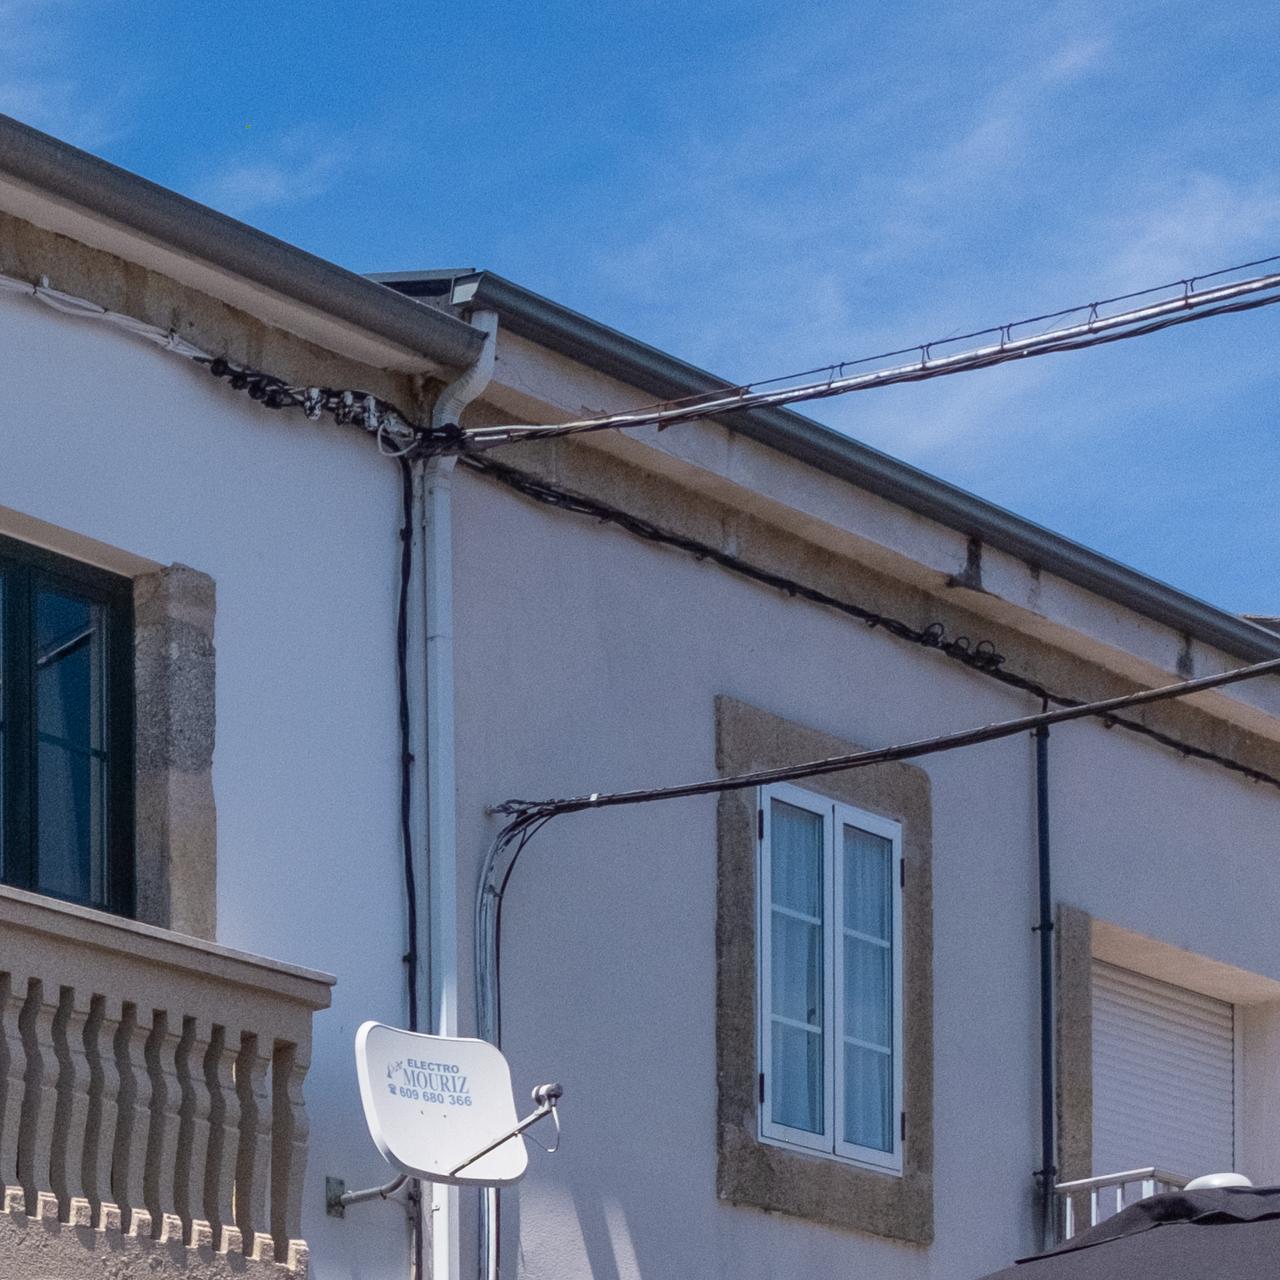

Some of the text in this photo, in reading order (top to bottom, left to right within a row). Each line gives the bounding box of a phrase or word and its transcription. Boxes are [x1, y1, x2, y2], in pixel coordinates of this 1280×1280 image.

[407, 1058, 459, 1074] ELECTRO
[403, 1069, 469, 1095] MOURIZ
[399, 1086, 472, 1107] 609 680 366
